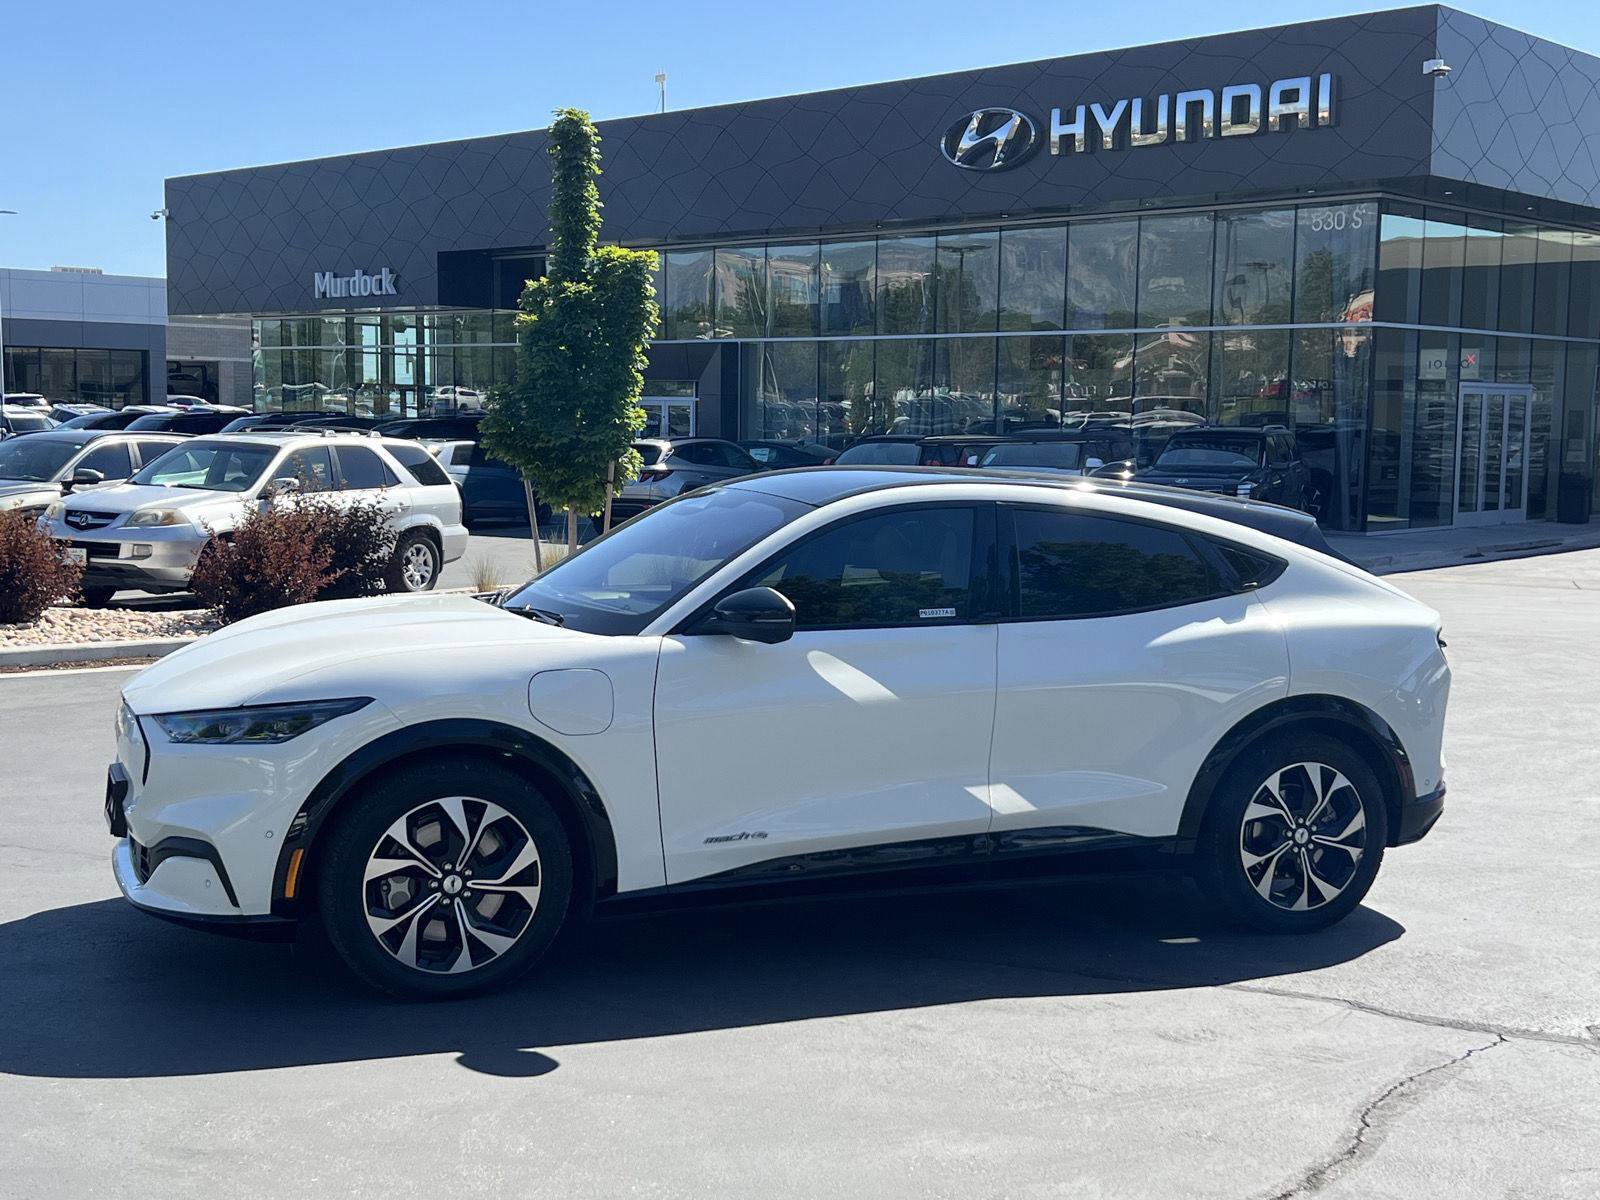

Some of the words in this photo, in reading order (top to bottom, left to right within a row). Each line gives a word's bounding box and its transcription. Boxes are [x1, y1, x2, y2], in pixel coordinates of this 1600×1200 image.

[1050, 73, 1333, 156] HYUNDAI
[1312, 210, 1346, 232] 530
[314, 267, 398, 299] Murdock
